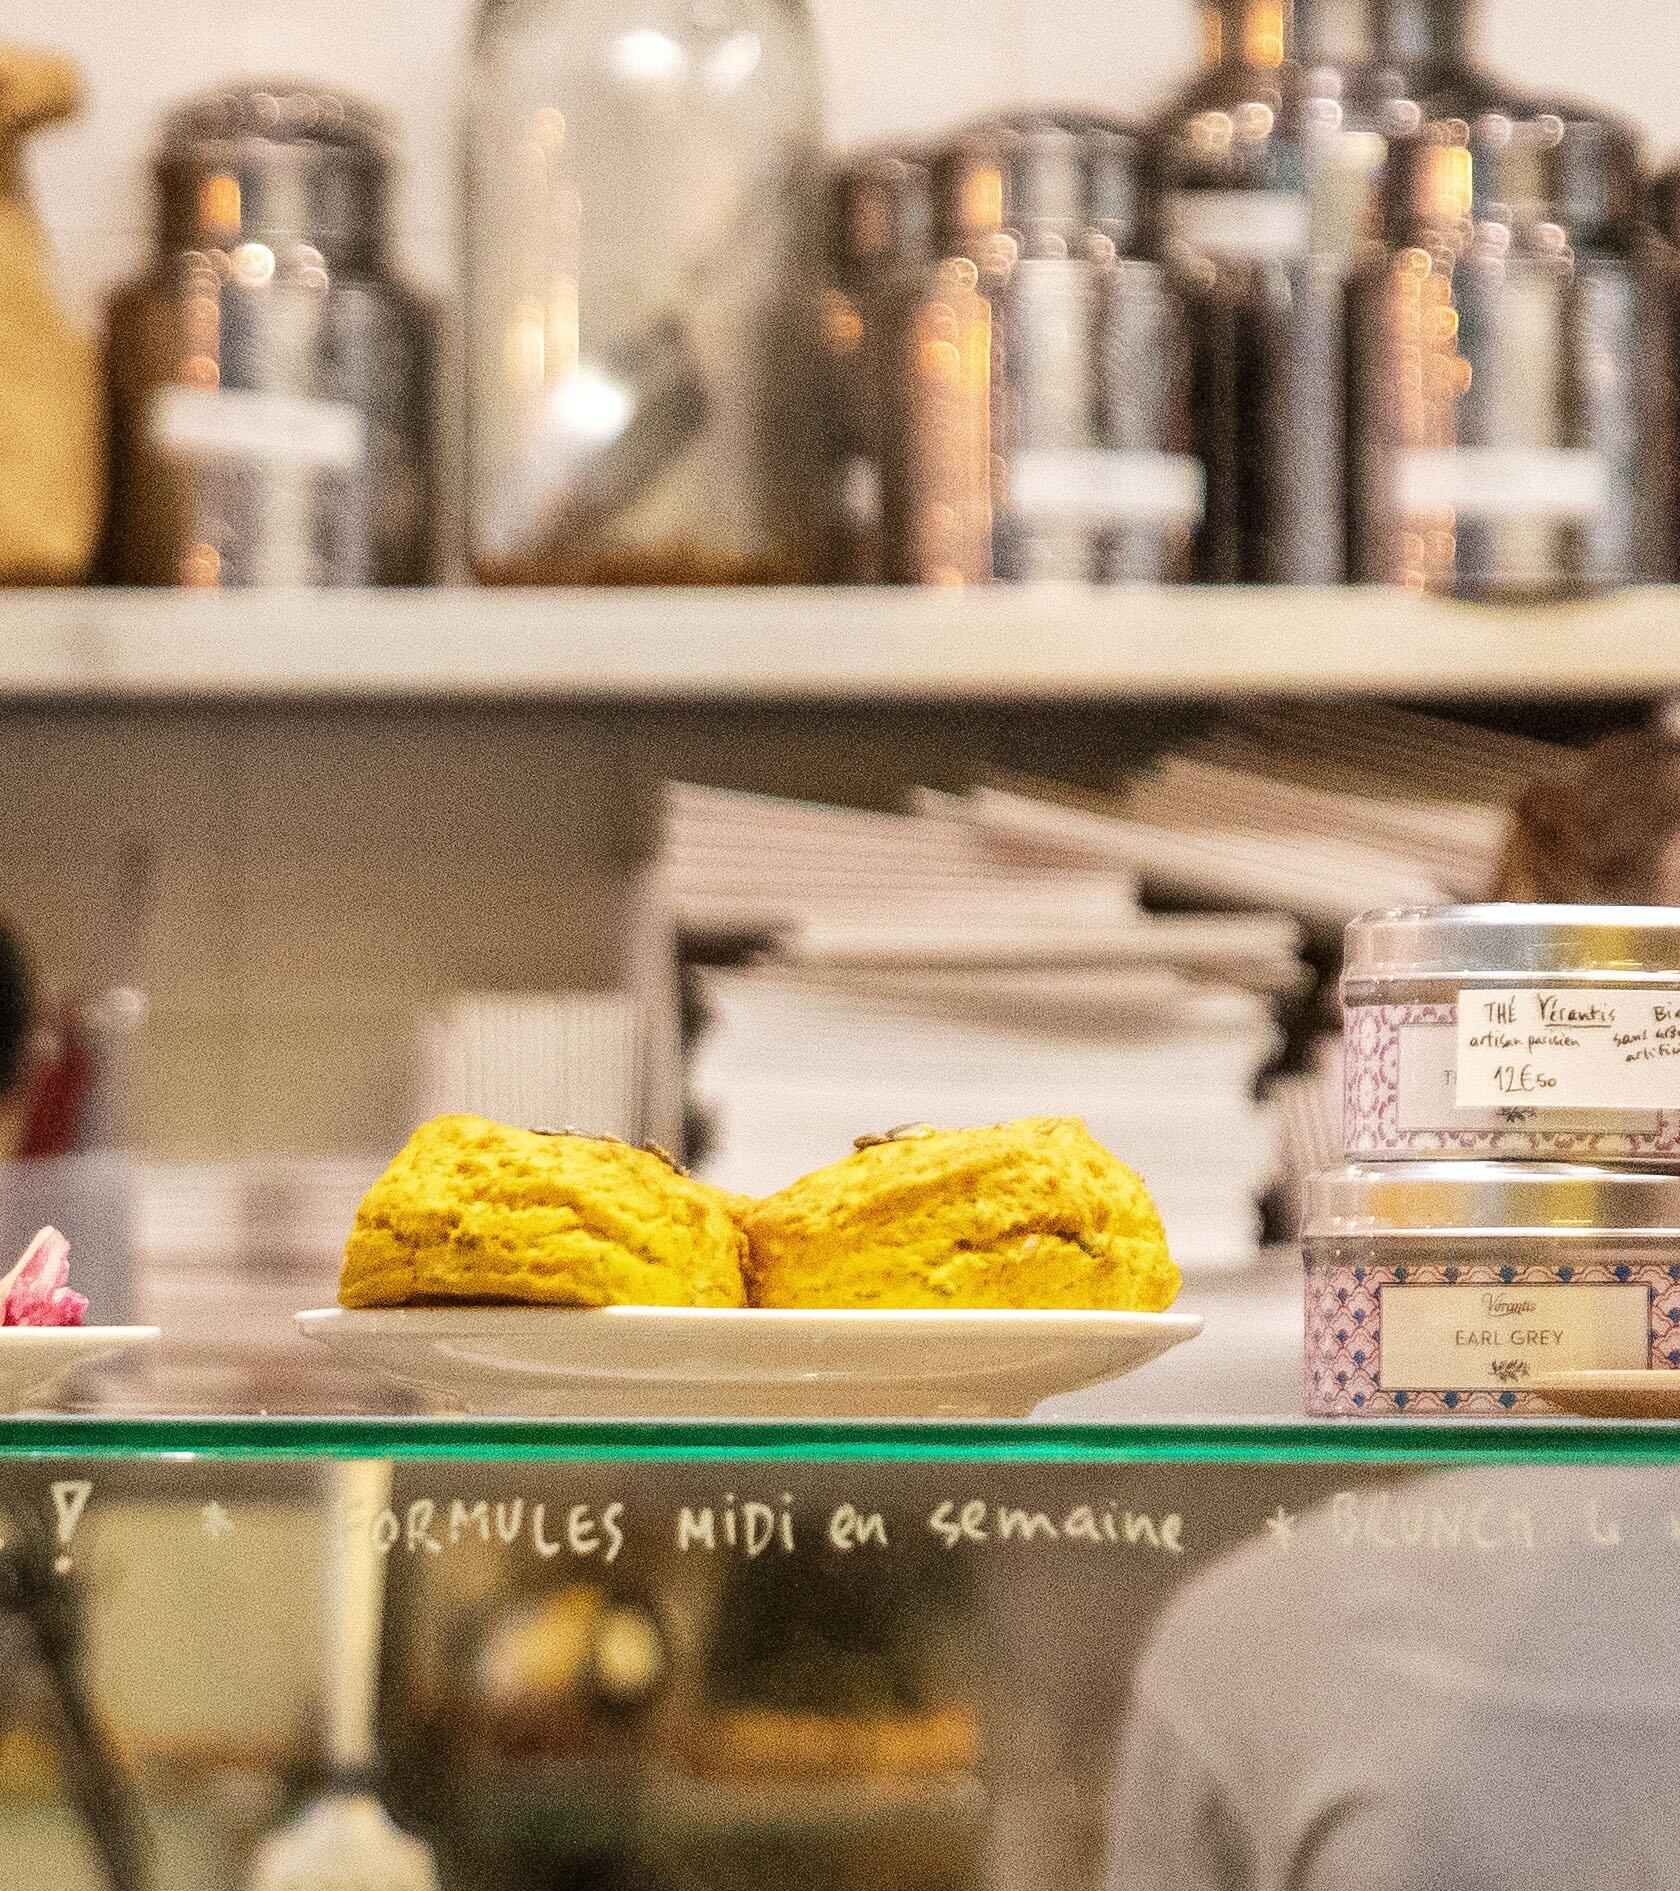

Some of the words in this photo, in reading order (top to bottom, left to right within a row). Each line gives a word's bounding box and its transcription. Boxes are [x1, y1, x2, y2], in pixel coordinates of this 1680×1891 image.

[1455, 1329, 1504, 1347] EARL
[1510, 1329, 1565, 1348] GREY
[929, 1497, 1185, 1552] semaine
